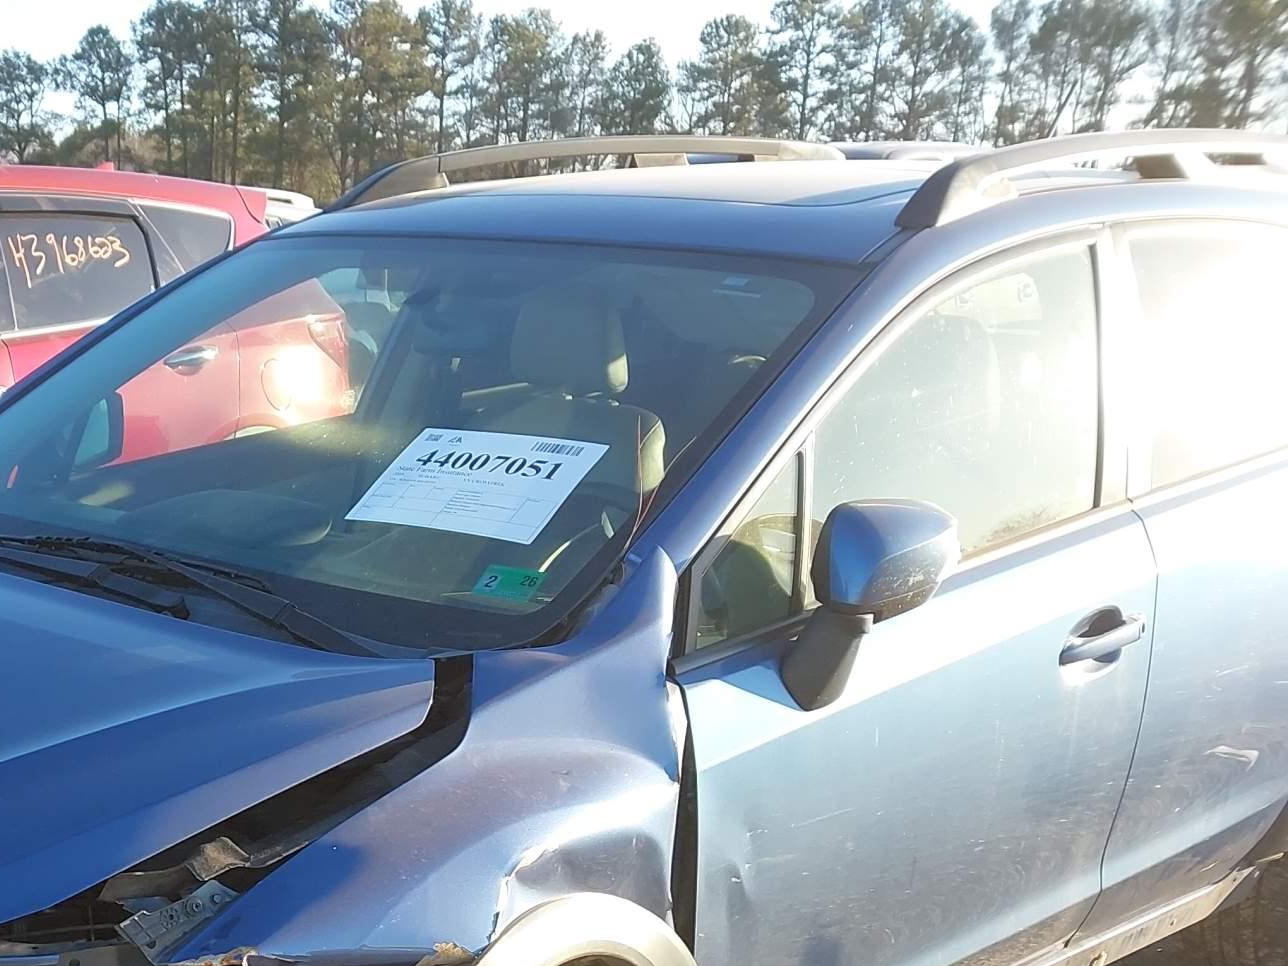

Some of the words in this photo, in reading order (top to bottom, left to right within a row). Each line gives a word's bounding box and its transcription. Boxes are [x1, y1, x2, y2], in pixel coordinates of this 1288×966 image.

[415, 448, 564, 481] 44007051
[484, 575, 499, 588] 2
[519, 575, 539, 588] 26
